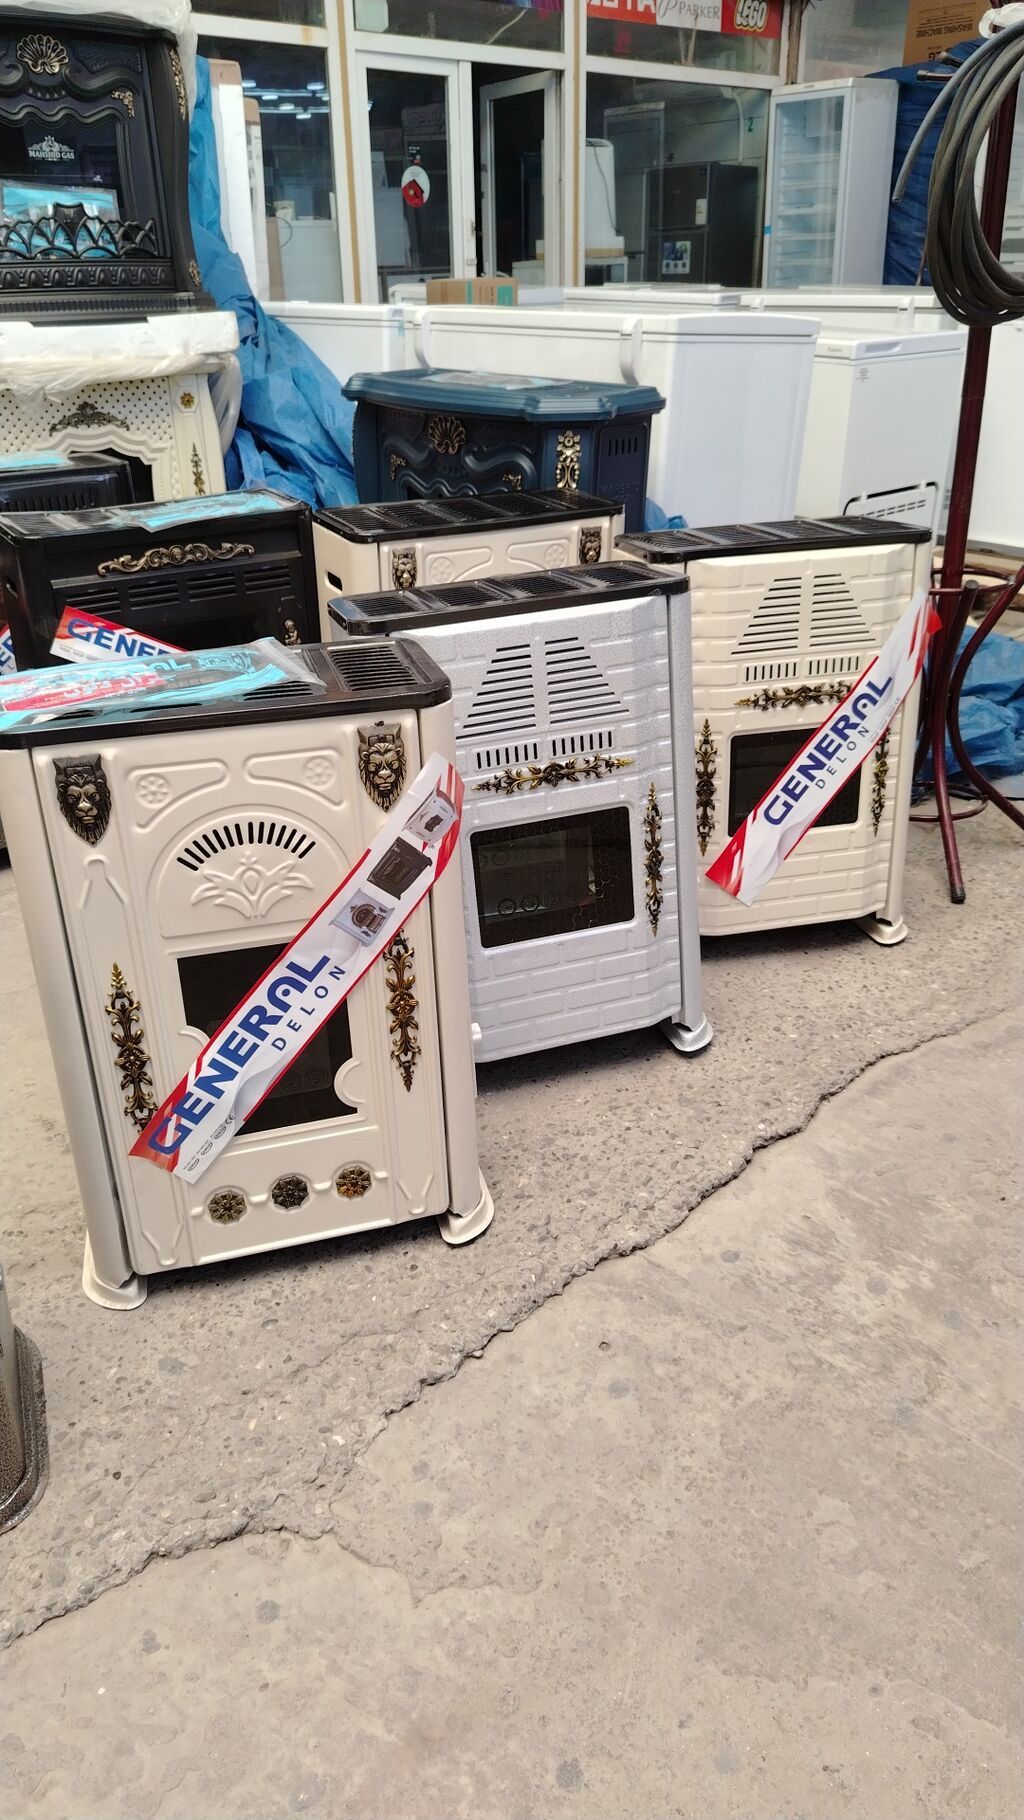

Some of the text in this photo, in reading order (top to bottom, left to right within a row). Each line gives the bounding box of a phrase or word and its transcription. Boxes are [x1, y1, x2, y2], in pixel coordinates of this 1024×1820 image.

[679, 1, 721, 19] PARKER
[735, 0, 767, 29] LEGO
[61, 151, 75, 159] GAS
[67, 618, 171, 657] GENE
[763, 676, 893, 826] GENERAL
[815, 726, 870, 790] DELON
[270, 965, 346, 1051] DELON
[147, 954, 331, 1155] GENERAL
